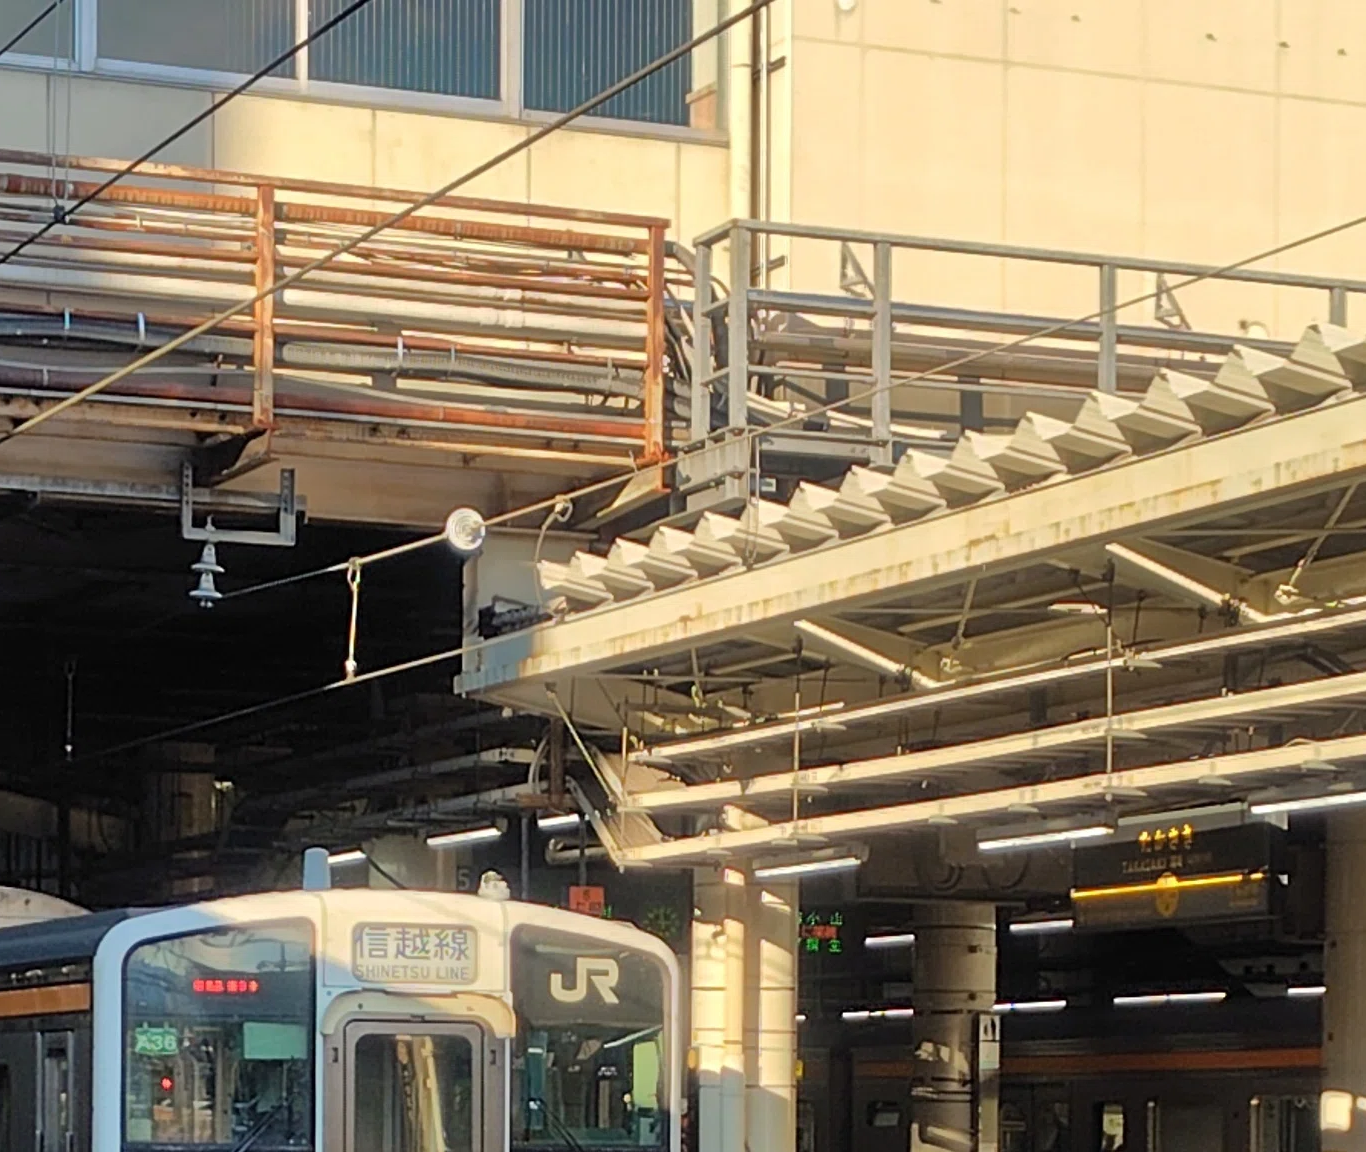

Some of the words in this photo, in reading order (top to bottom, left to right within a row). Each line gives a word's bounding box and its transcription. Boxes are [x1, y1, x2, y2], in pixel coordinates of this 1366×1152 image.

[355, 926, 469, 961] 信越線
[355, 964, 431, 980] SHINETSU
[436, 965, 470, 981] LINE
[550, 957, 619, 1004] JR
[136, 1034, 177, 1051] A36
